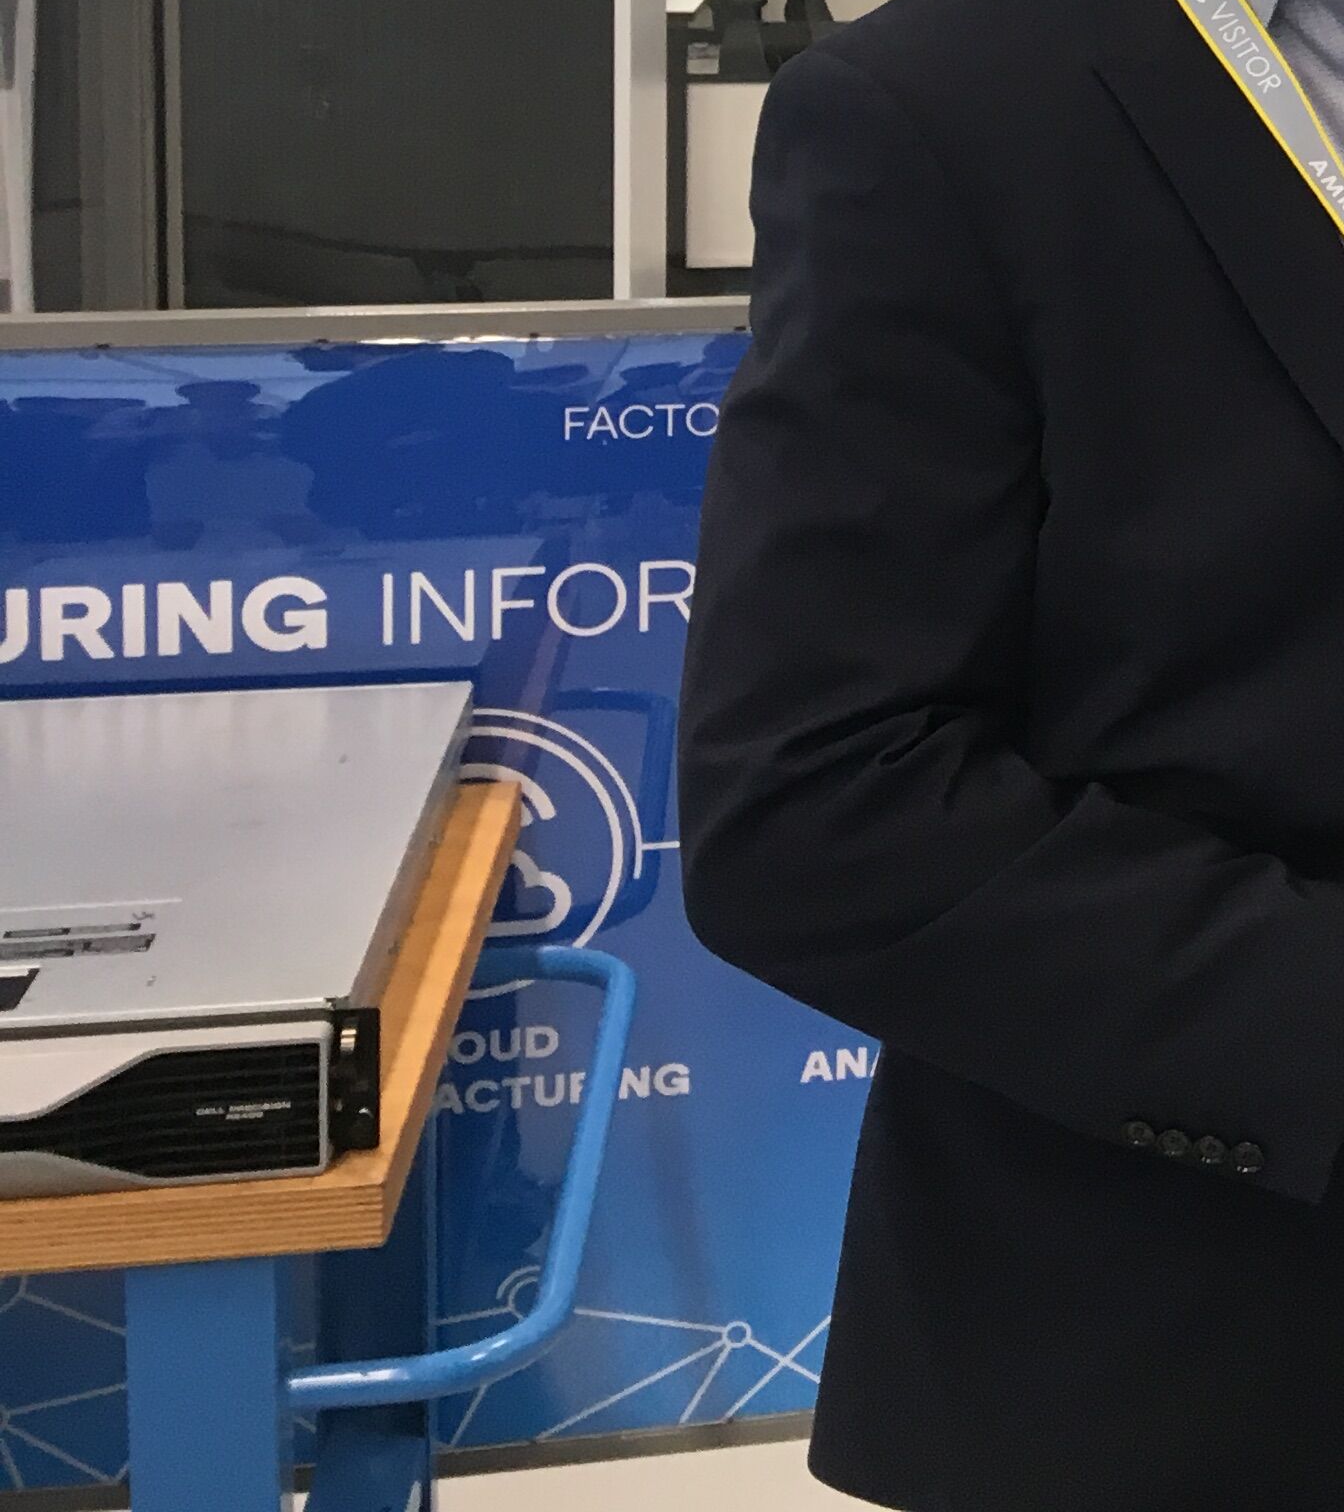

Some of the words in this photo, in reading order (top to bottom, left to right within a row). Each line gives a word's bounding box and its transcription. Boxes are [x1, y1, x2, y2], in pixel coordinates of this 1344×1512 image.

[1211, 1, 1282, 94] VISITOR
[564, 402, 719, 440] FACTO
[382, 560, 698, 646] INFOR
[447, 1025, 560, 1065] OUD
[800, 1046, 879, 1084] AN
